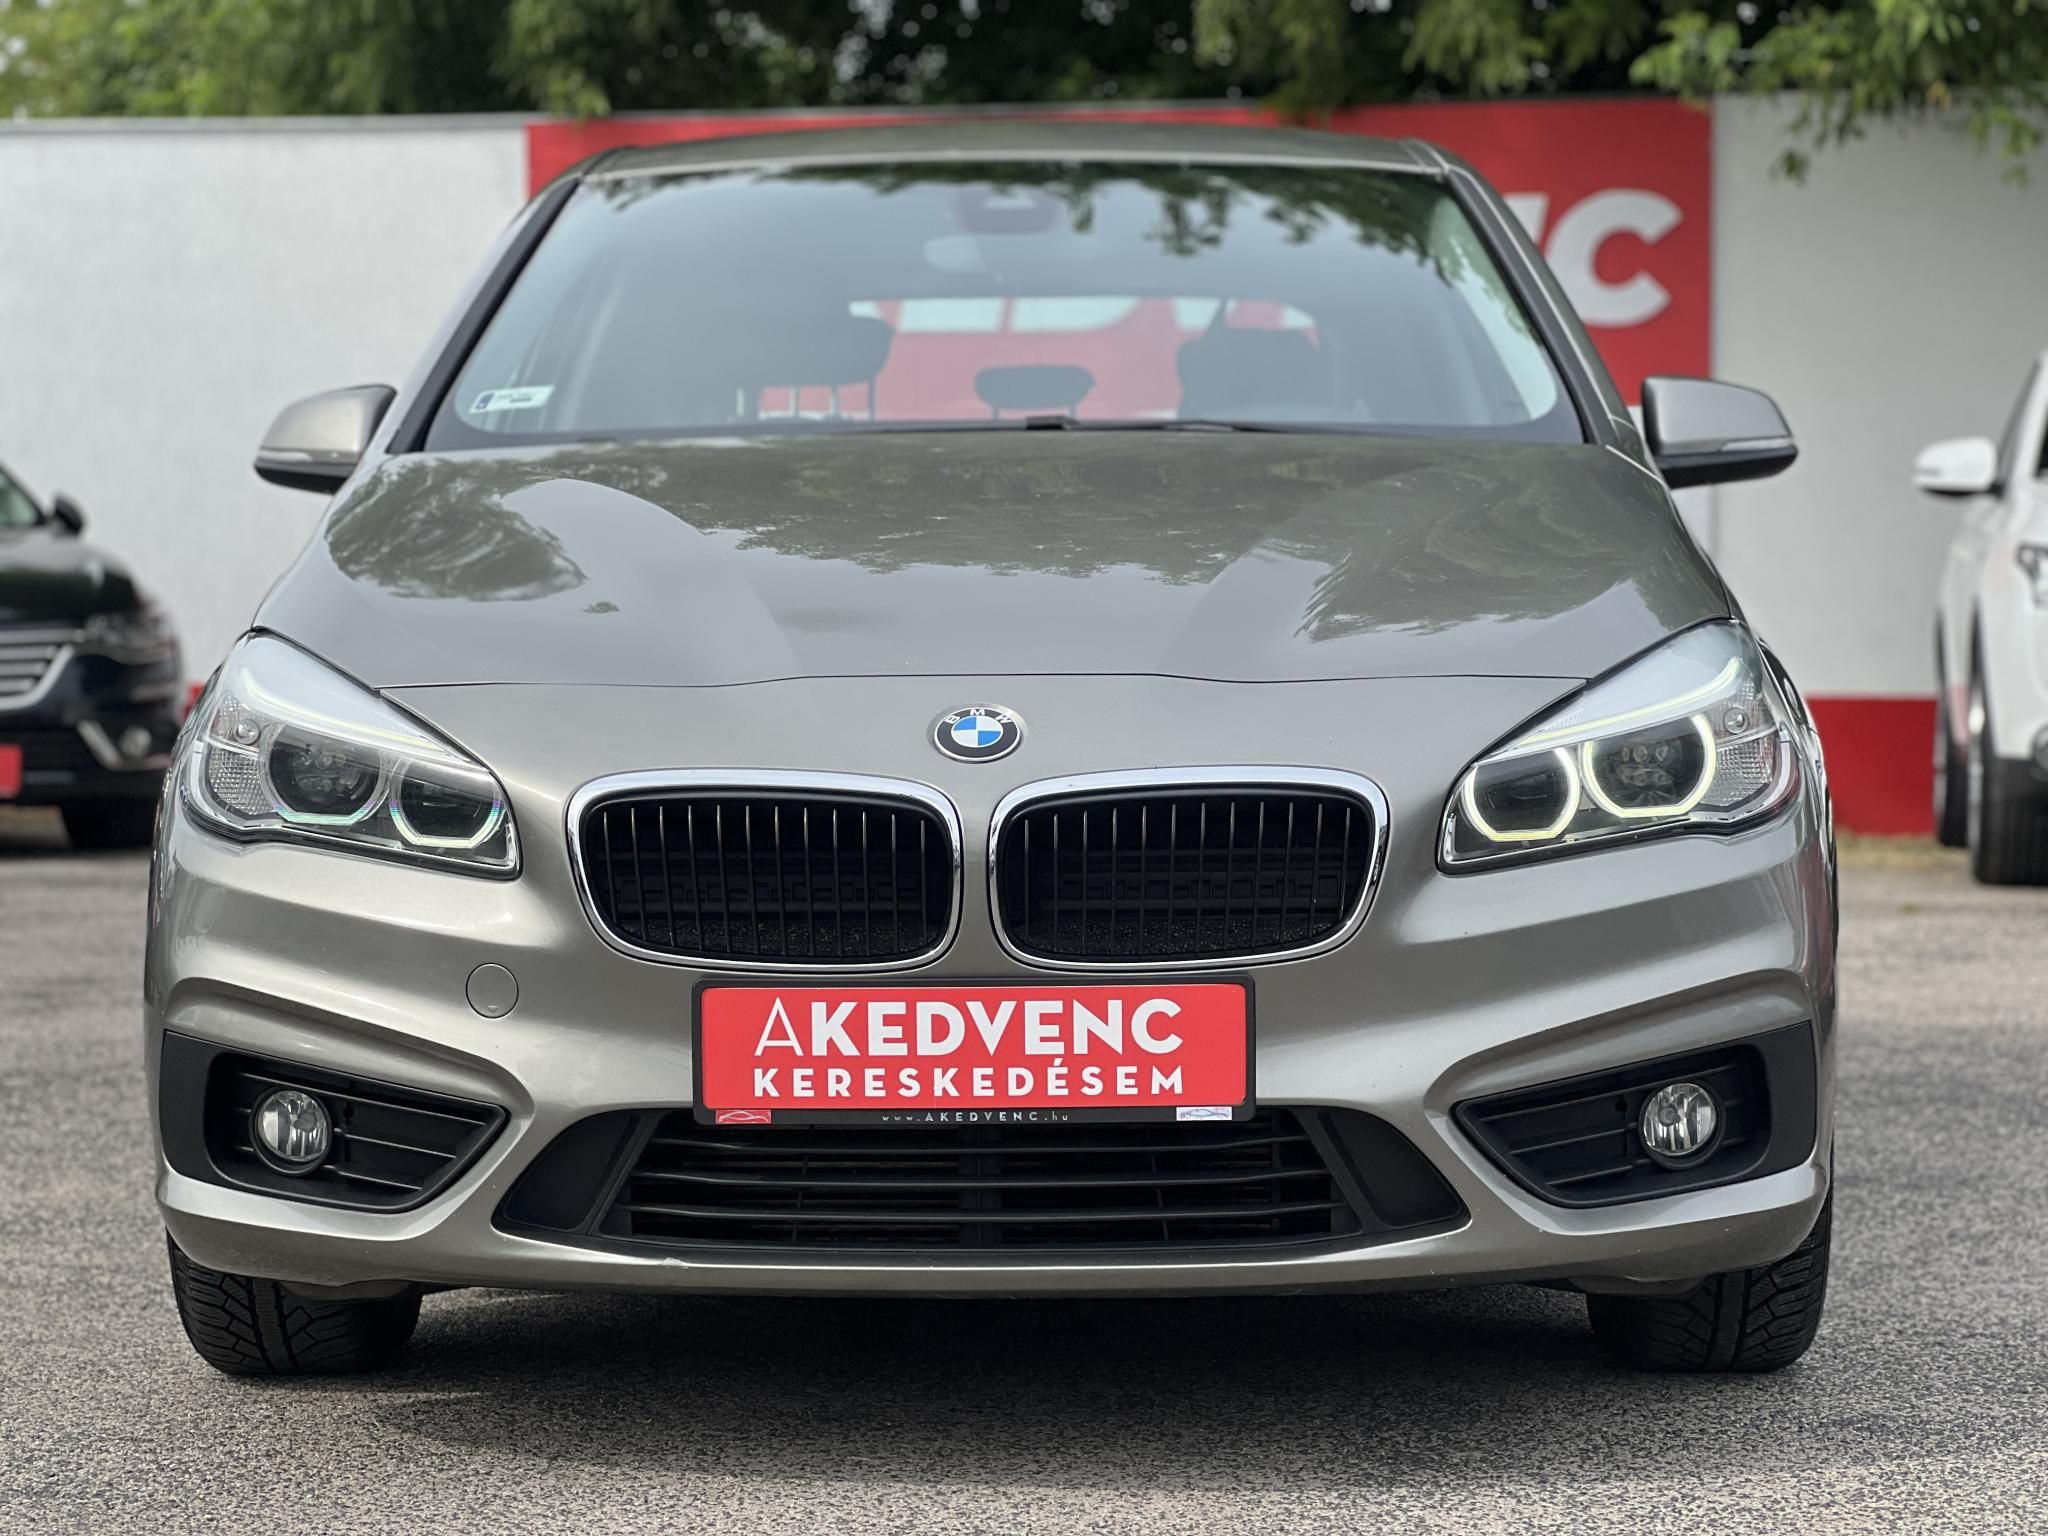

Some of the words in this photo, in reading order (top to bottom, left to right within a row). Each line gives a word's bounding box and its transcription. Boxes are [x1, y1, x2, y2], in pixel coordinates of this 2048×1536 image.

[943, 708, 1013, 724] BMW
[754, 1058, 1183, 1098] KERESKEDÉSEM
[882, 1111, 1068, 1123] www.AKEDVENC.hu
